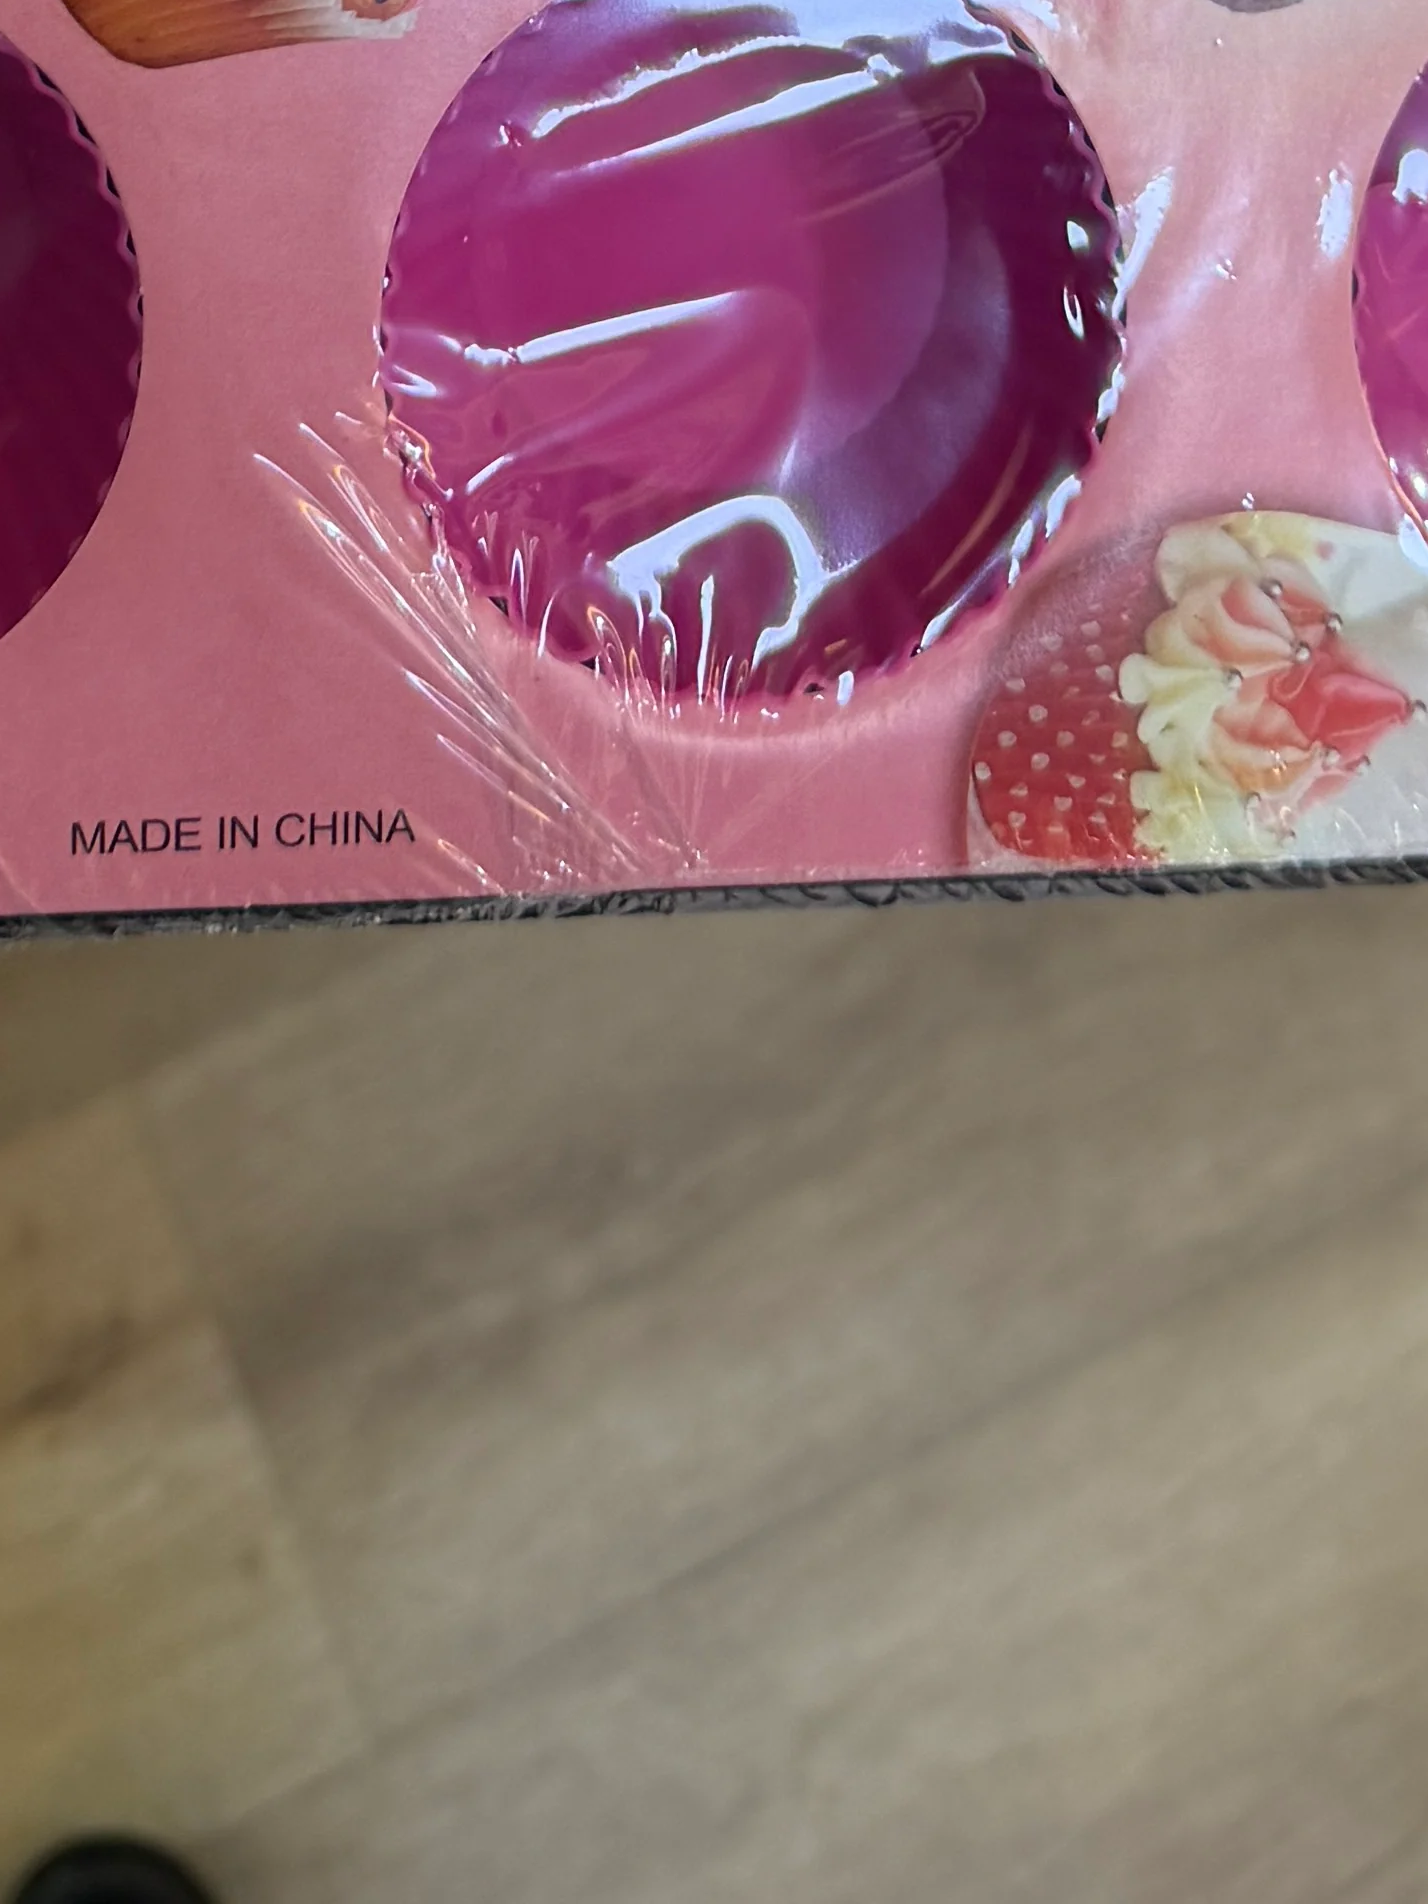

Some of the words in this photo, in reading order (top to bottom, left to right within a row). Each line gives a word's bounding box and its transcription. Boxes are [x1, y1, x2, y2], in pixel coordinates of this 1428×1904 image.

[70, 815, 202, 856] MADE
[218, 813, 259, 850] IN
[274, 807, 416, 848] CHINA
